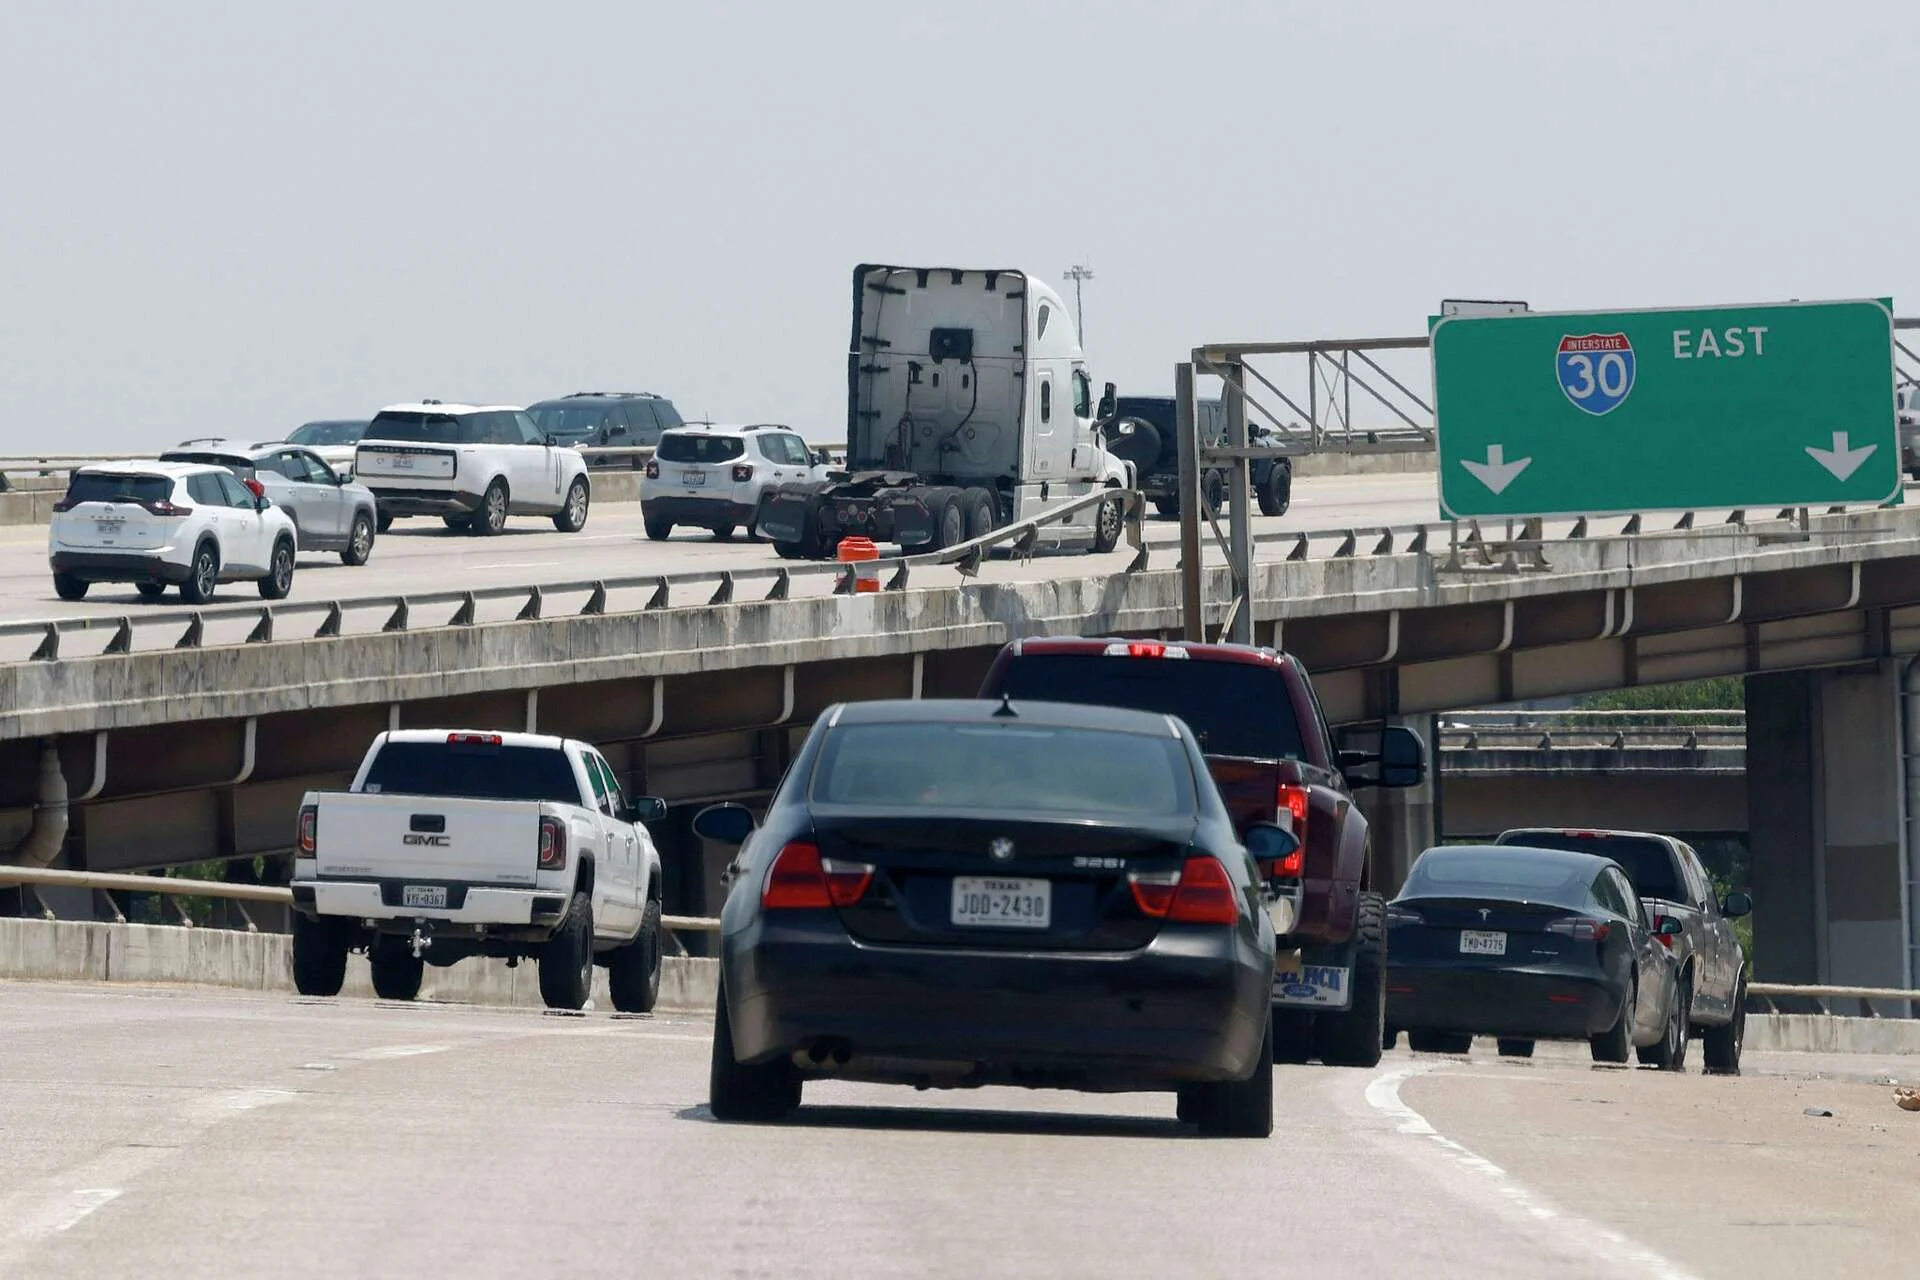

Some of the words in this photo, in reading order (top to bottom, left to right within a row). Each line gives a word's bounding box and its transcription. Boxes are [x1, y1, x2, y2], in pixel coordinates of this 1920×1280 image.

[1567, 338, 1622, 351] INTERSTATE
[1673, 326, 1768, 359] EAST
[1566, 353, 1628, 399] 30
[403, 834, 451, 848] GMC
[984, 880, 1022, 890] TEXAS
